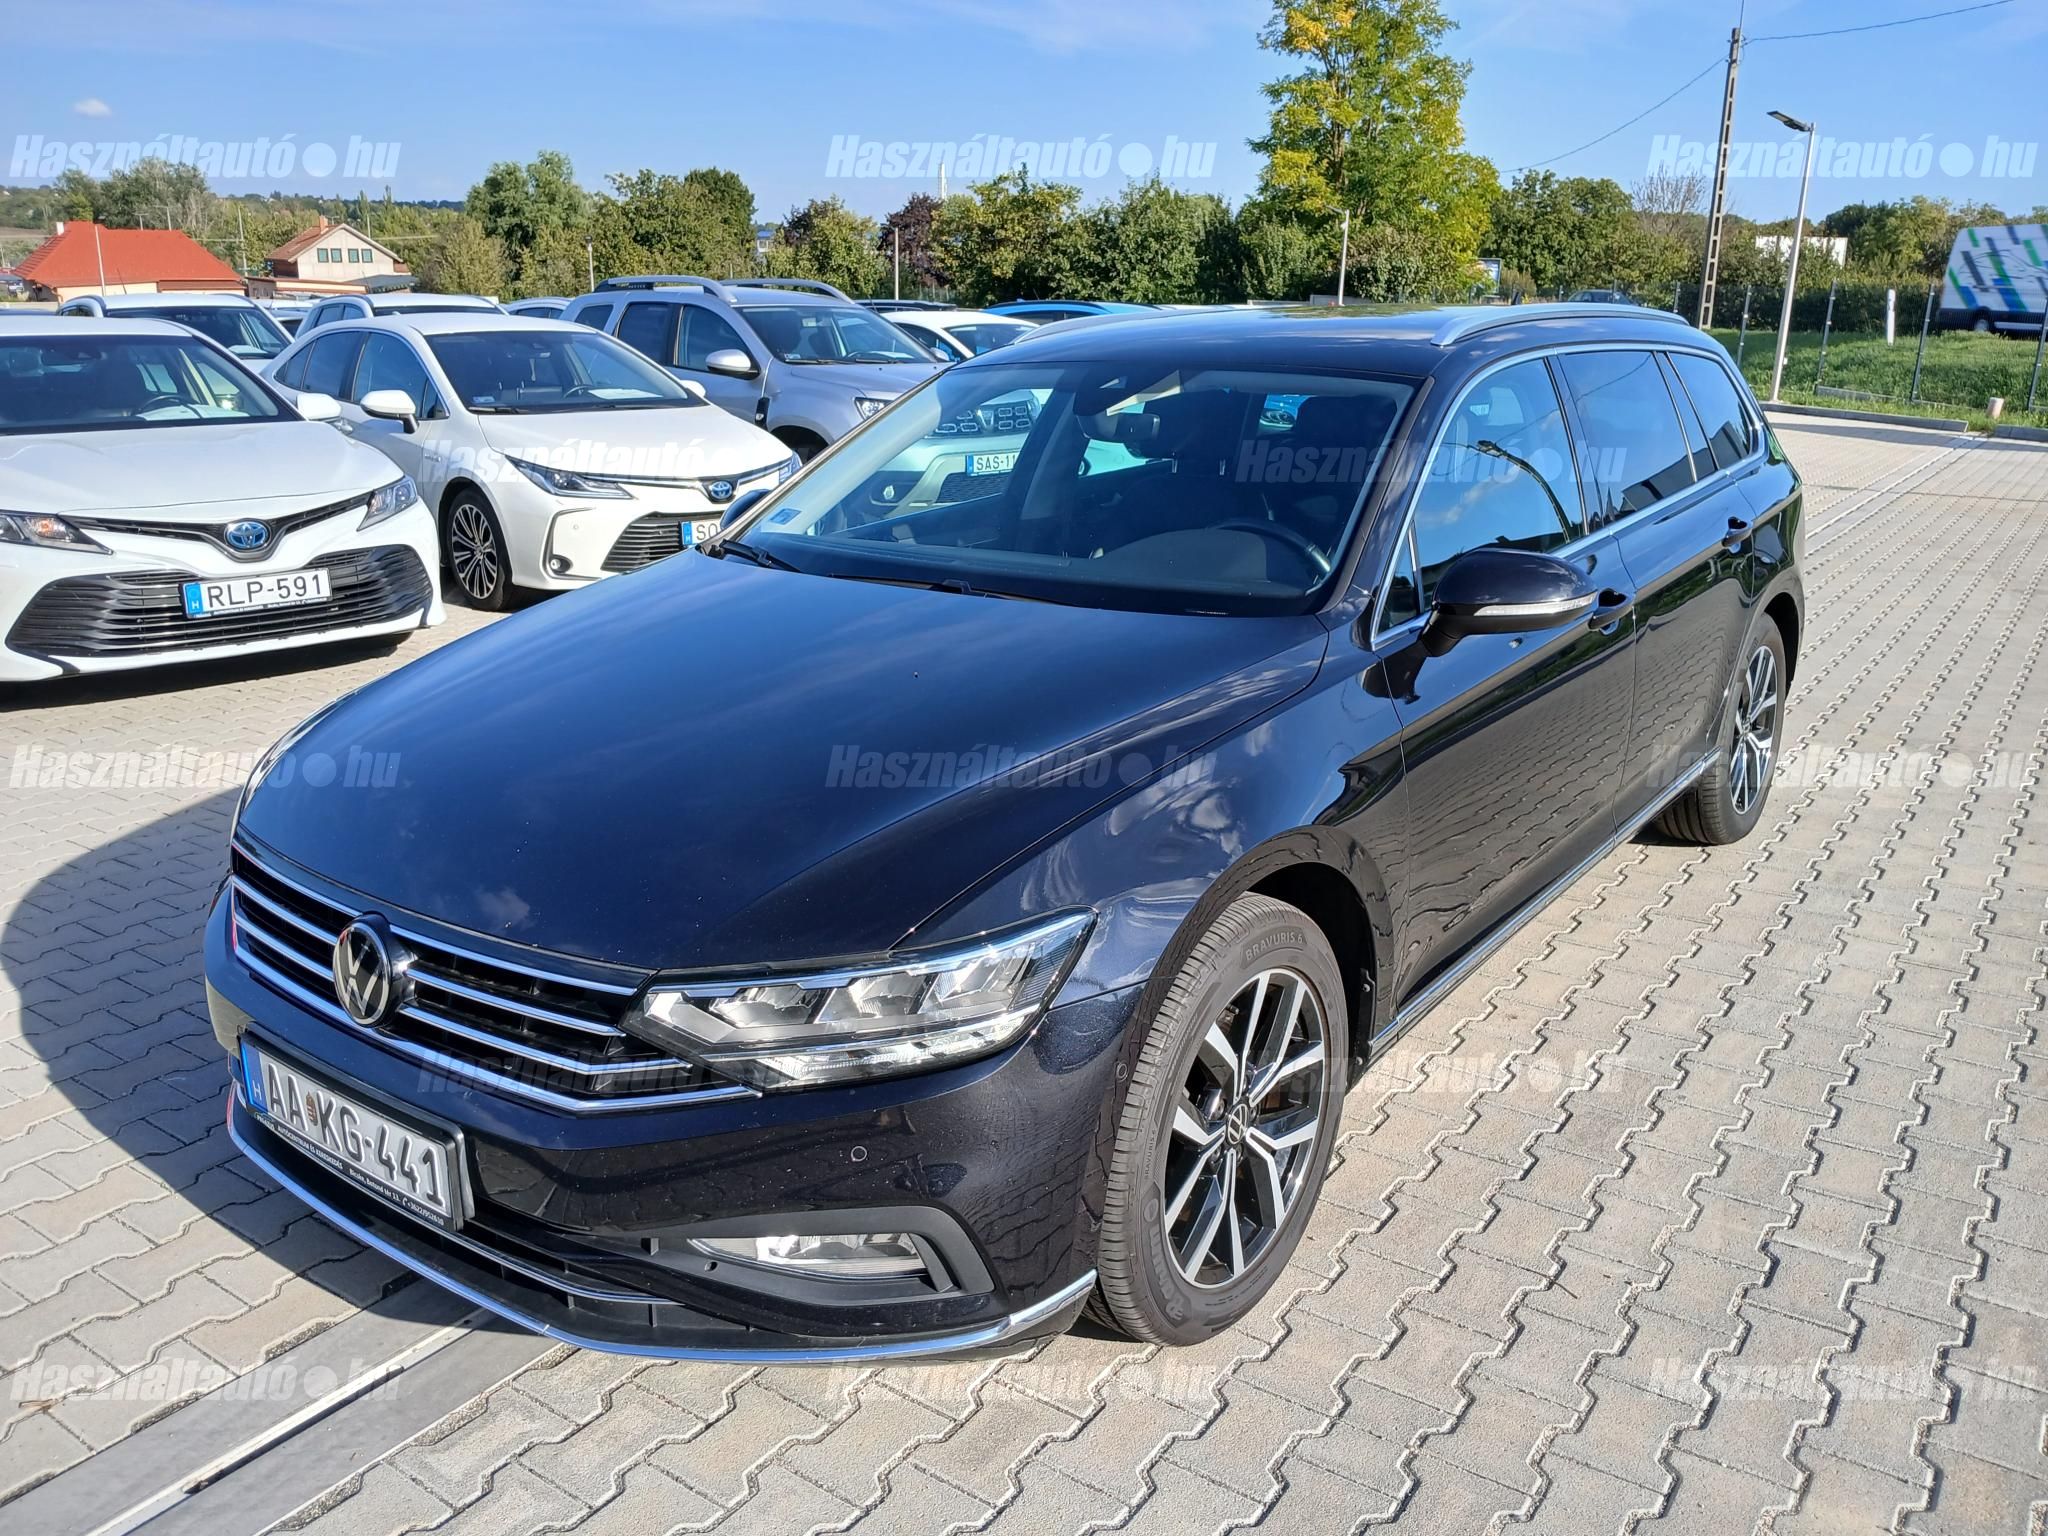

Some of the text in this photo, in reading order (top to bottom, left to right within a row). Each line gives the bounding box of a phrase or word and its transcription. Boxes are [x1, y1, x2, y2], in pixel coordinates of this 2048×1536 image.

[206, 573, 322, 608] RLP-591
[191, 600, 200, 610] H
[1245, 931, 1296, 961] BRAVURIS
[252, 1079, 262, 1101] H
